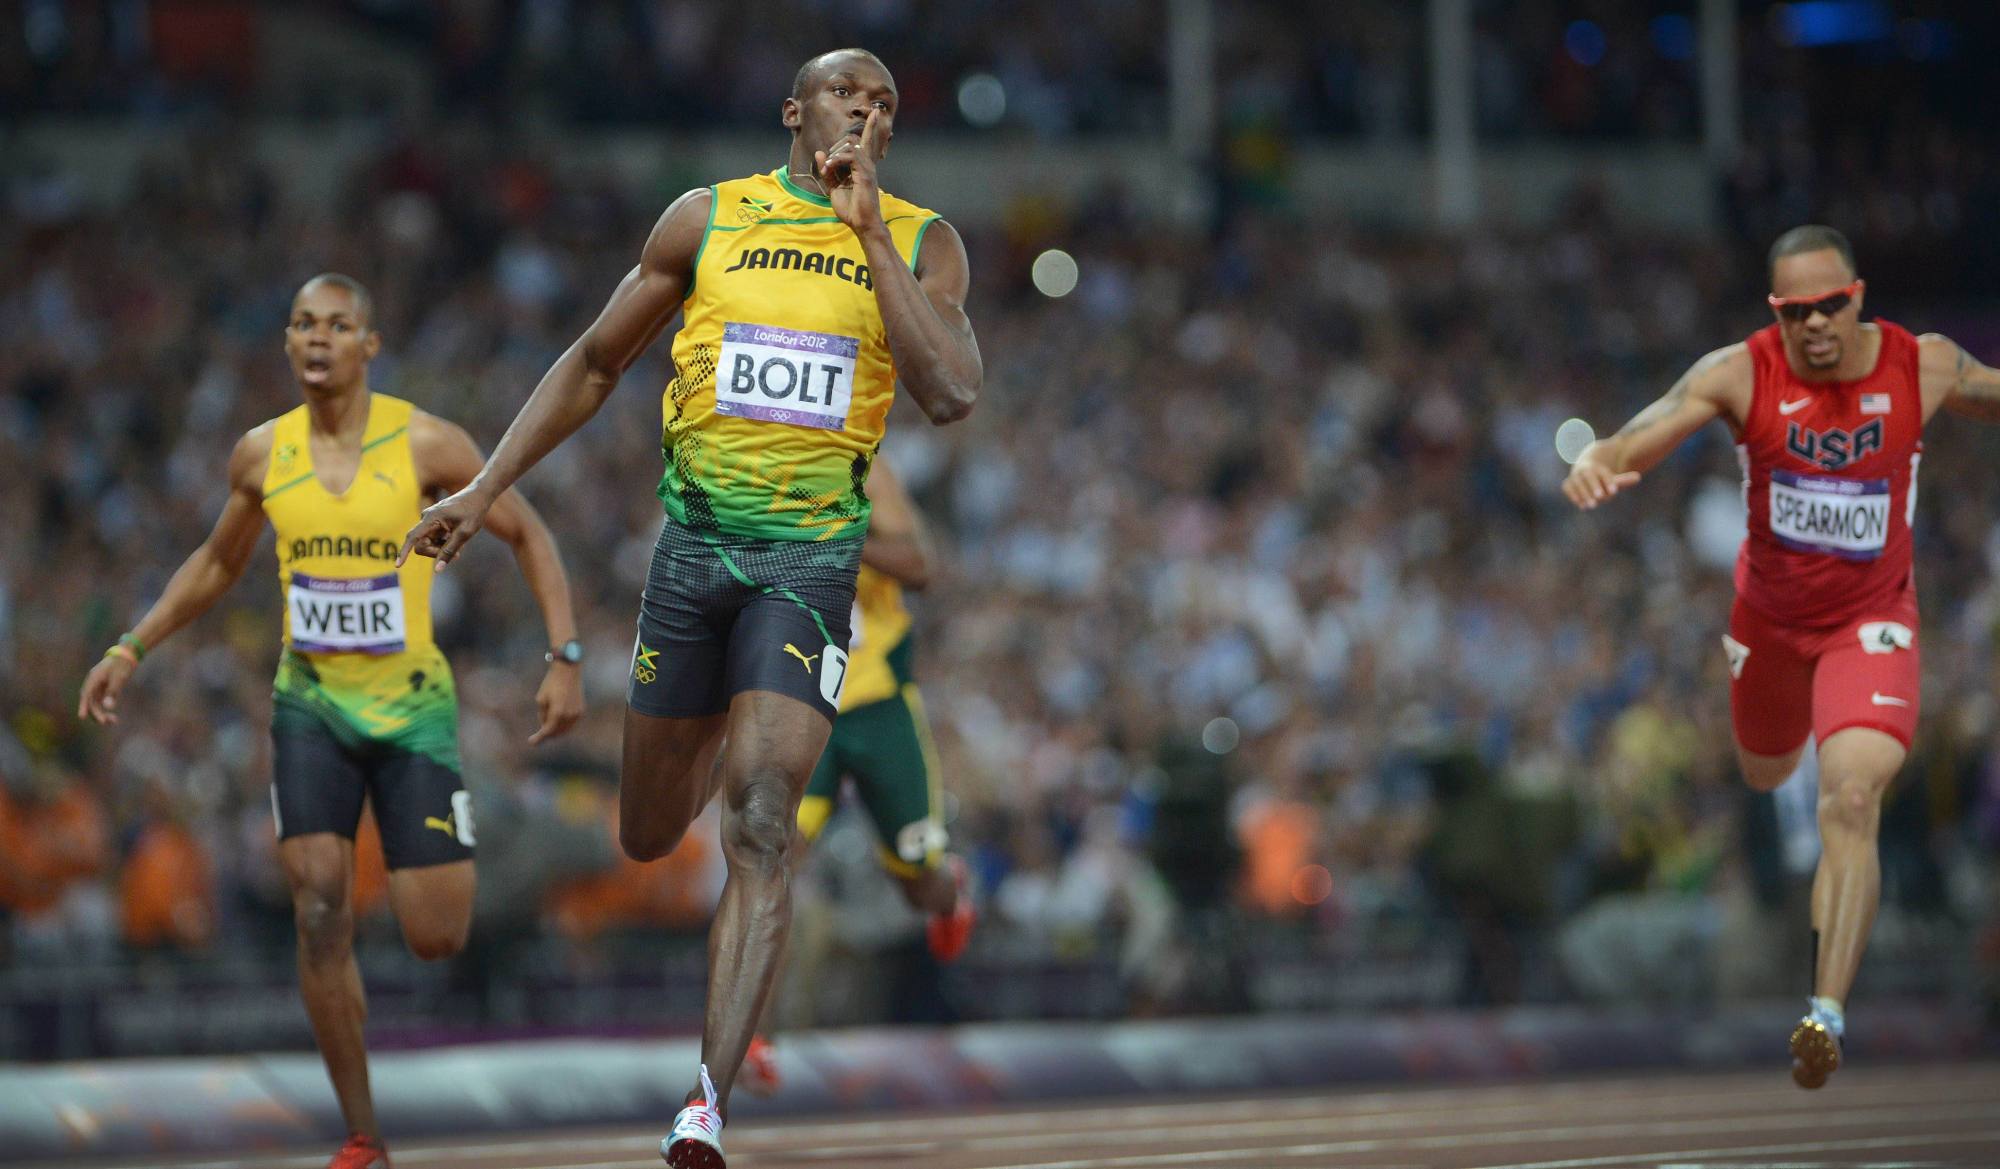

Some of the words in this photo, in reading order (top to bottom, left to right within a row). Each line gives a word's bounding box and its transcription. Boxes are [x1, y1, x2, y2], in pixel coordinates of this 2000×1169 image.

[725, 248, 872, 291] JAMAICA
[754, 328, 797, 346] London
[799, 335, 828, 350] 2012
[731, 353, 843, 406] BOLT
[1786, 416, 1884, 470] USA
[1775, 493, 1885, 540] SPEARMON
[287, 535, 401, 562] JAMAICA
[297, 599, 392, 633] WEIR
[834, 654, 847, 699] 7
